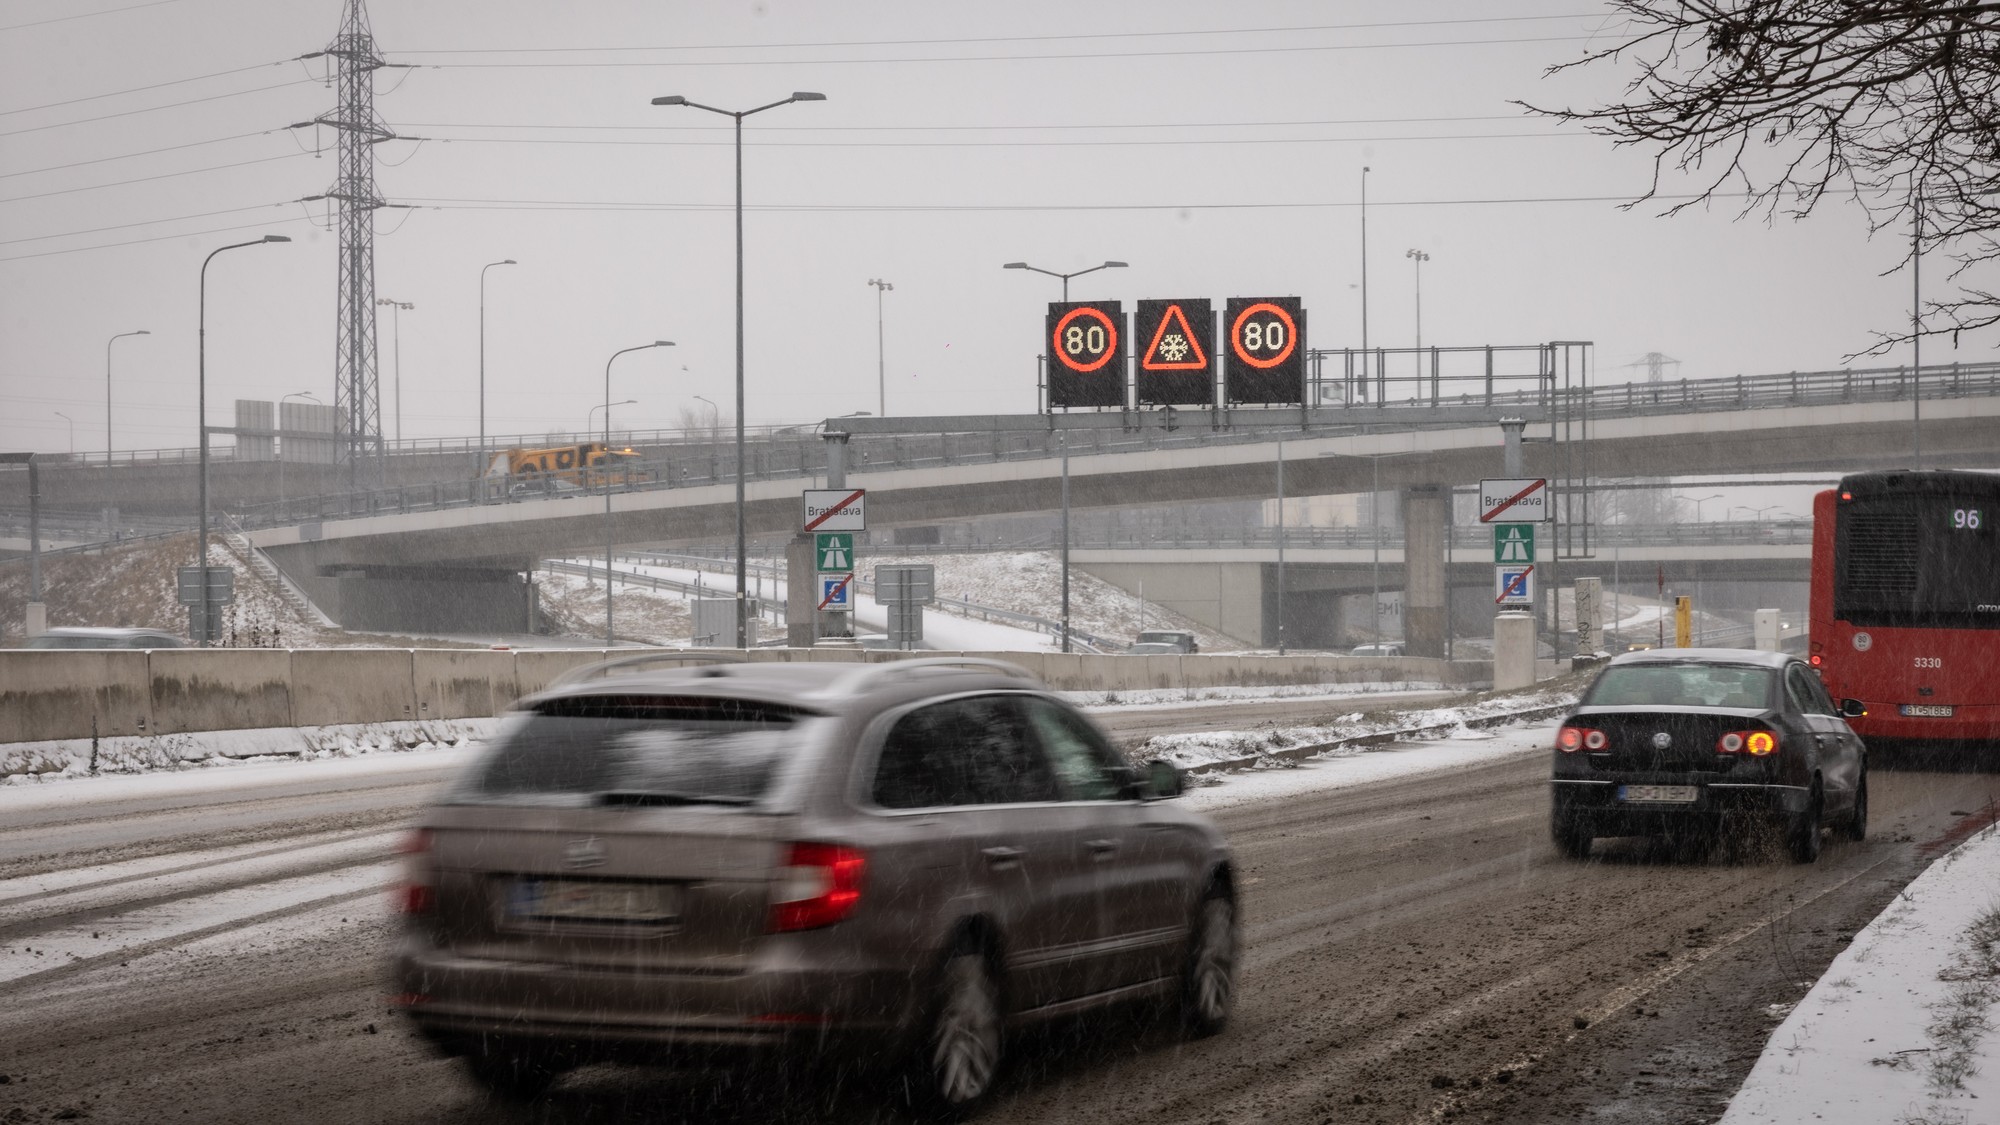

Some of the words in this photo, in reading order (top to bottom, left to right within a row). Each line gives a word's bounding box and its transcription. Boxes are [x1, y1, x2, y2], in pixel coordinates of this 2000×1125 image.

[1066, 325, 1104, 355] 80
[1244, 321, 1284, 351] 80
[1953, 508, 1979, 529] 96
[1914, 657, 1942, 668] 3330
